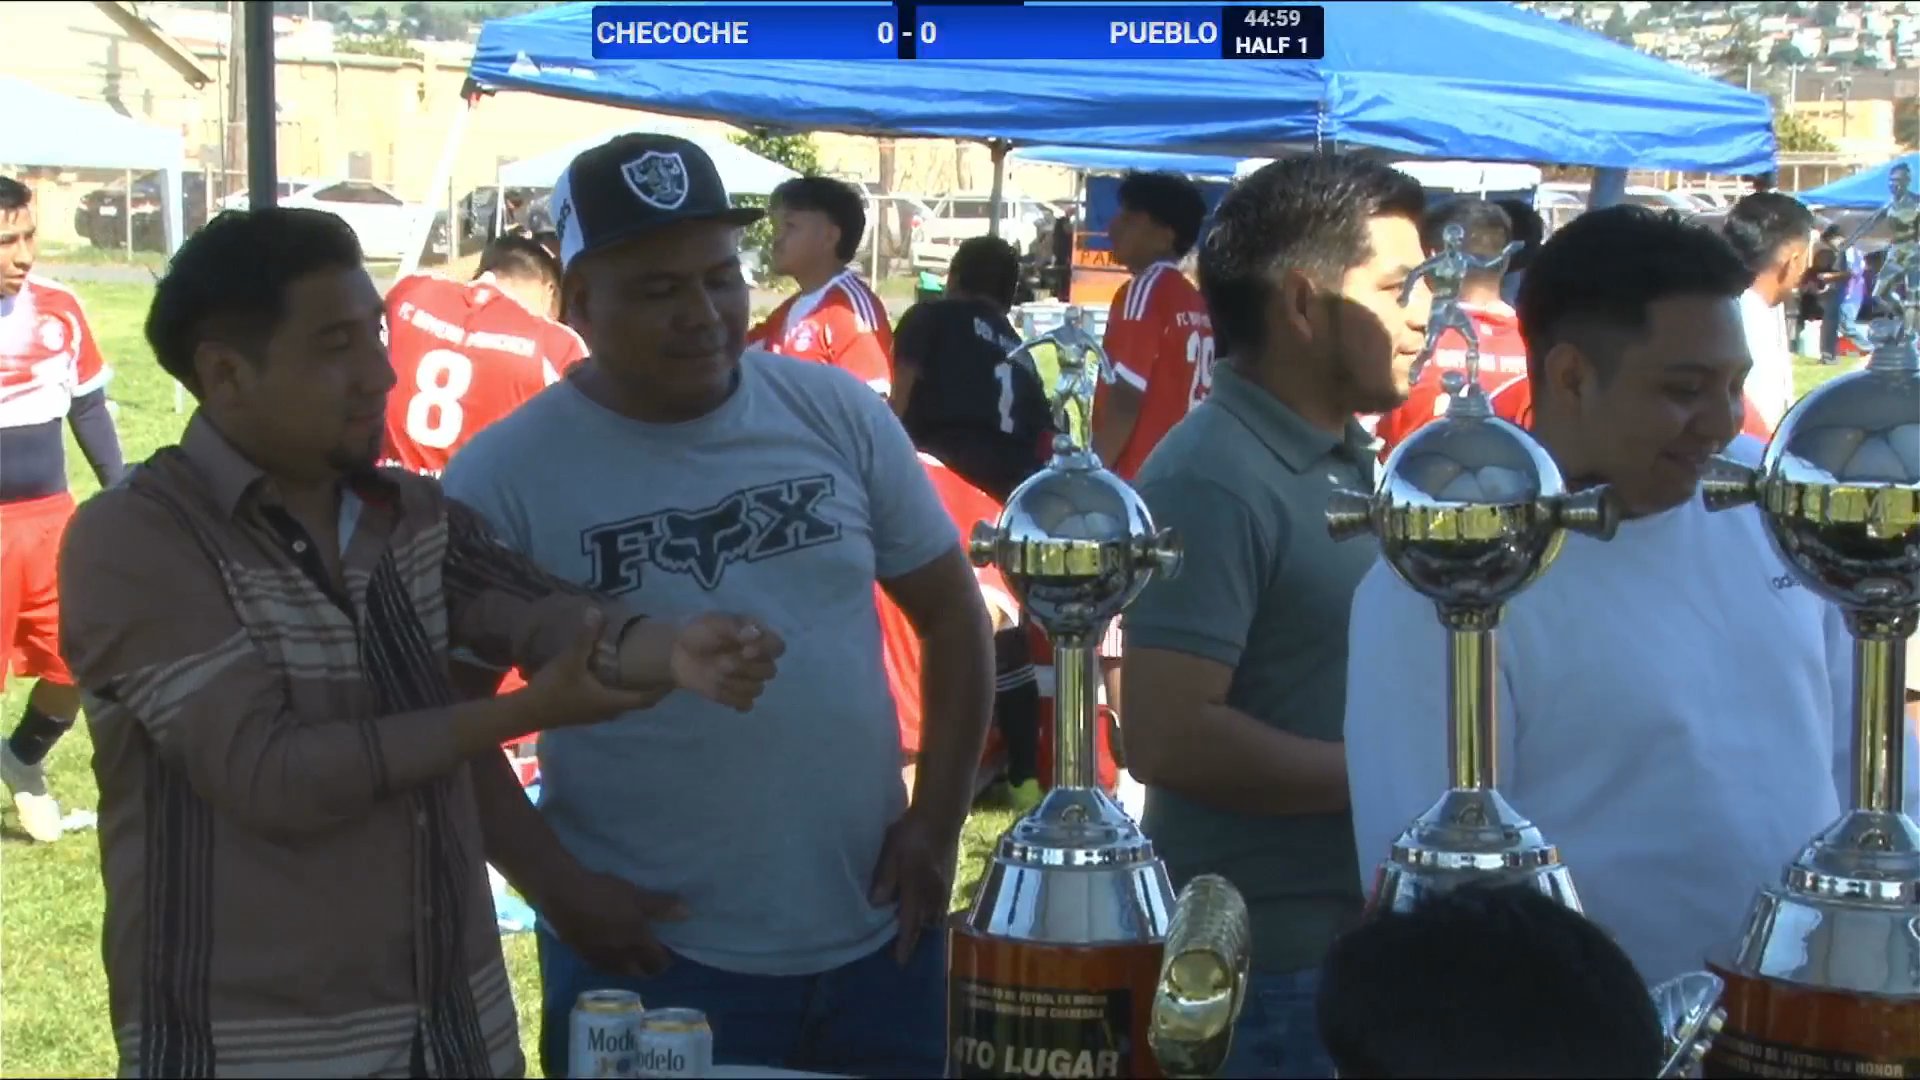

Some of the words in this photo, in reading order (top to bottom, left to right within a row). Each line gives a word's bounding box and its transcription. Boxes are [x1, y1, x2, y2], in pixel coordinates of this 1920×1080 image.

[406, 348, 473, 449] 8
[995, 362, 1015, 435] 1
[580, 474, 842, 597] FOX
[1004, 1045, 1119, 1079] LUGAR
[1855, 1060, 1904, 1077] HONOR
